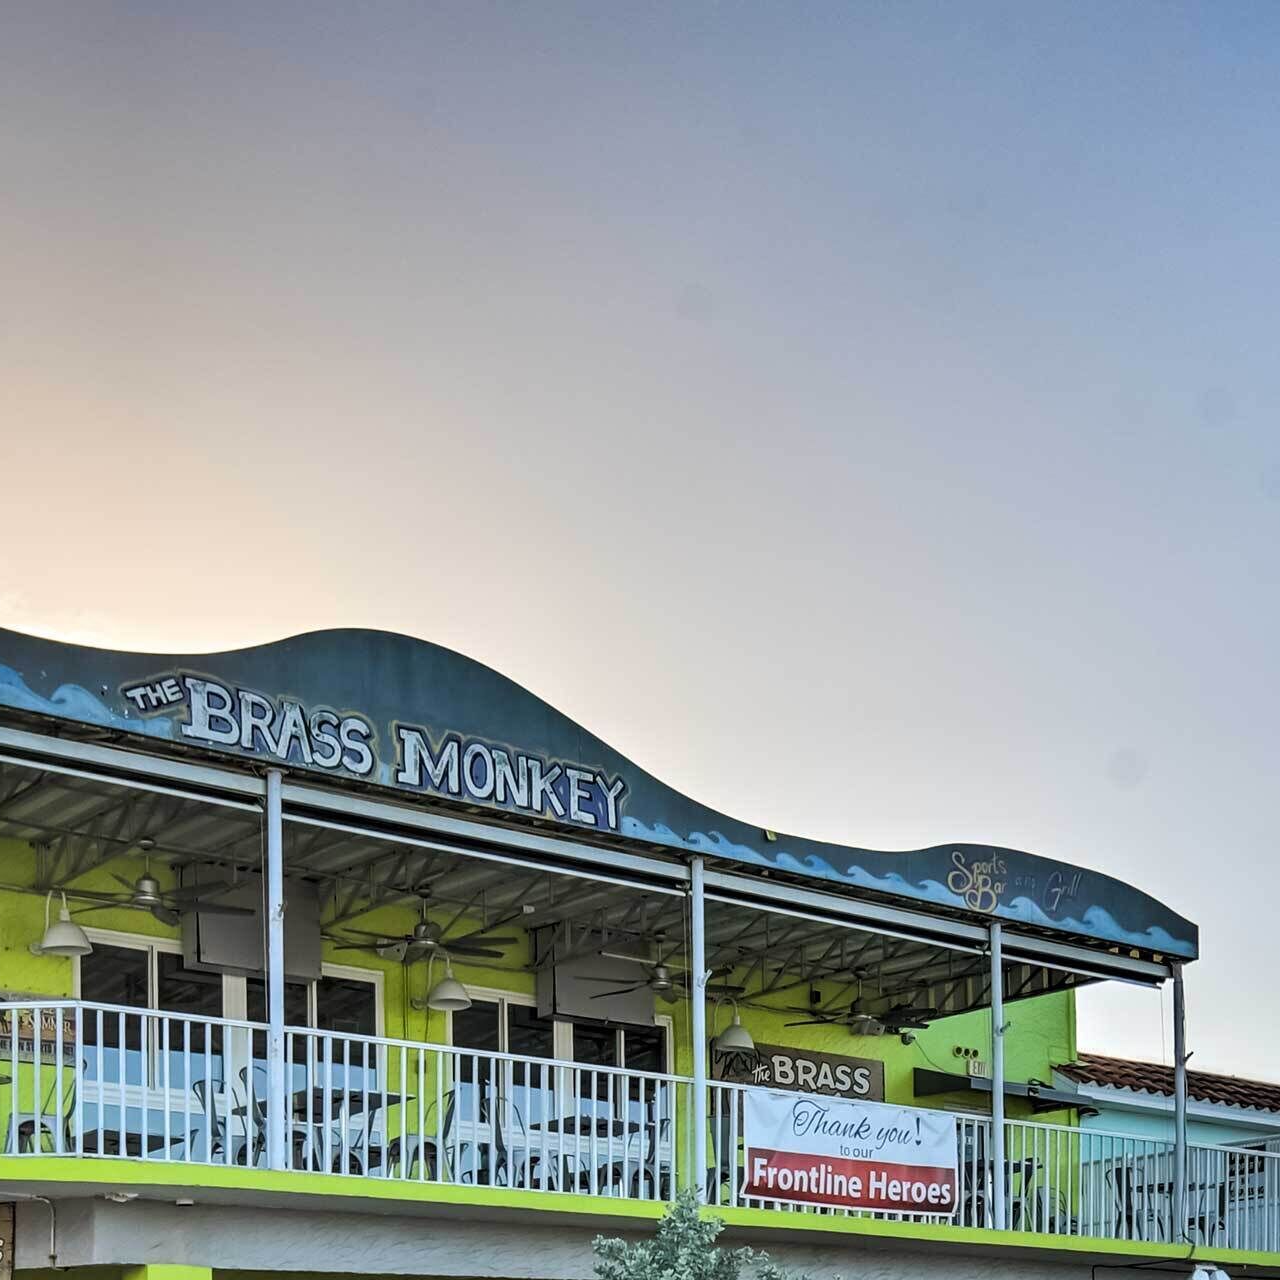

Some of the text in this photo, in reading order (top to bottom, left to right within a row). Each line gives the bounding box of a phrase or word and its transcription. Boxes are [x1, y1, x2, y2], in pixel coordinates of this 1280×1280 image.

[126, 677, 624, 829] THE BRASS MONKEY
[948, 851, 1008, 894] Sports
[965, 874, 1007, 914] Bar
[1043, 871, 1084, 913] Grill
[752, 1054, 871, 1095] the BRASS
[792, 1099, 871, 1138] Thank
[839, 1144, 875, 1159] to our
[753, 1158, 952, 1206] Frontline Heroes
